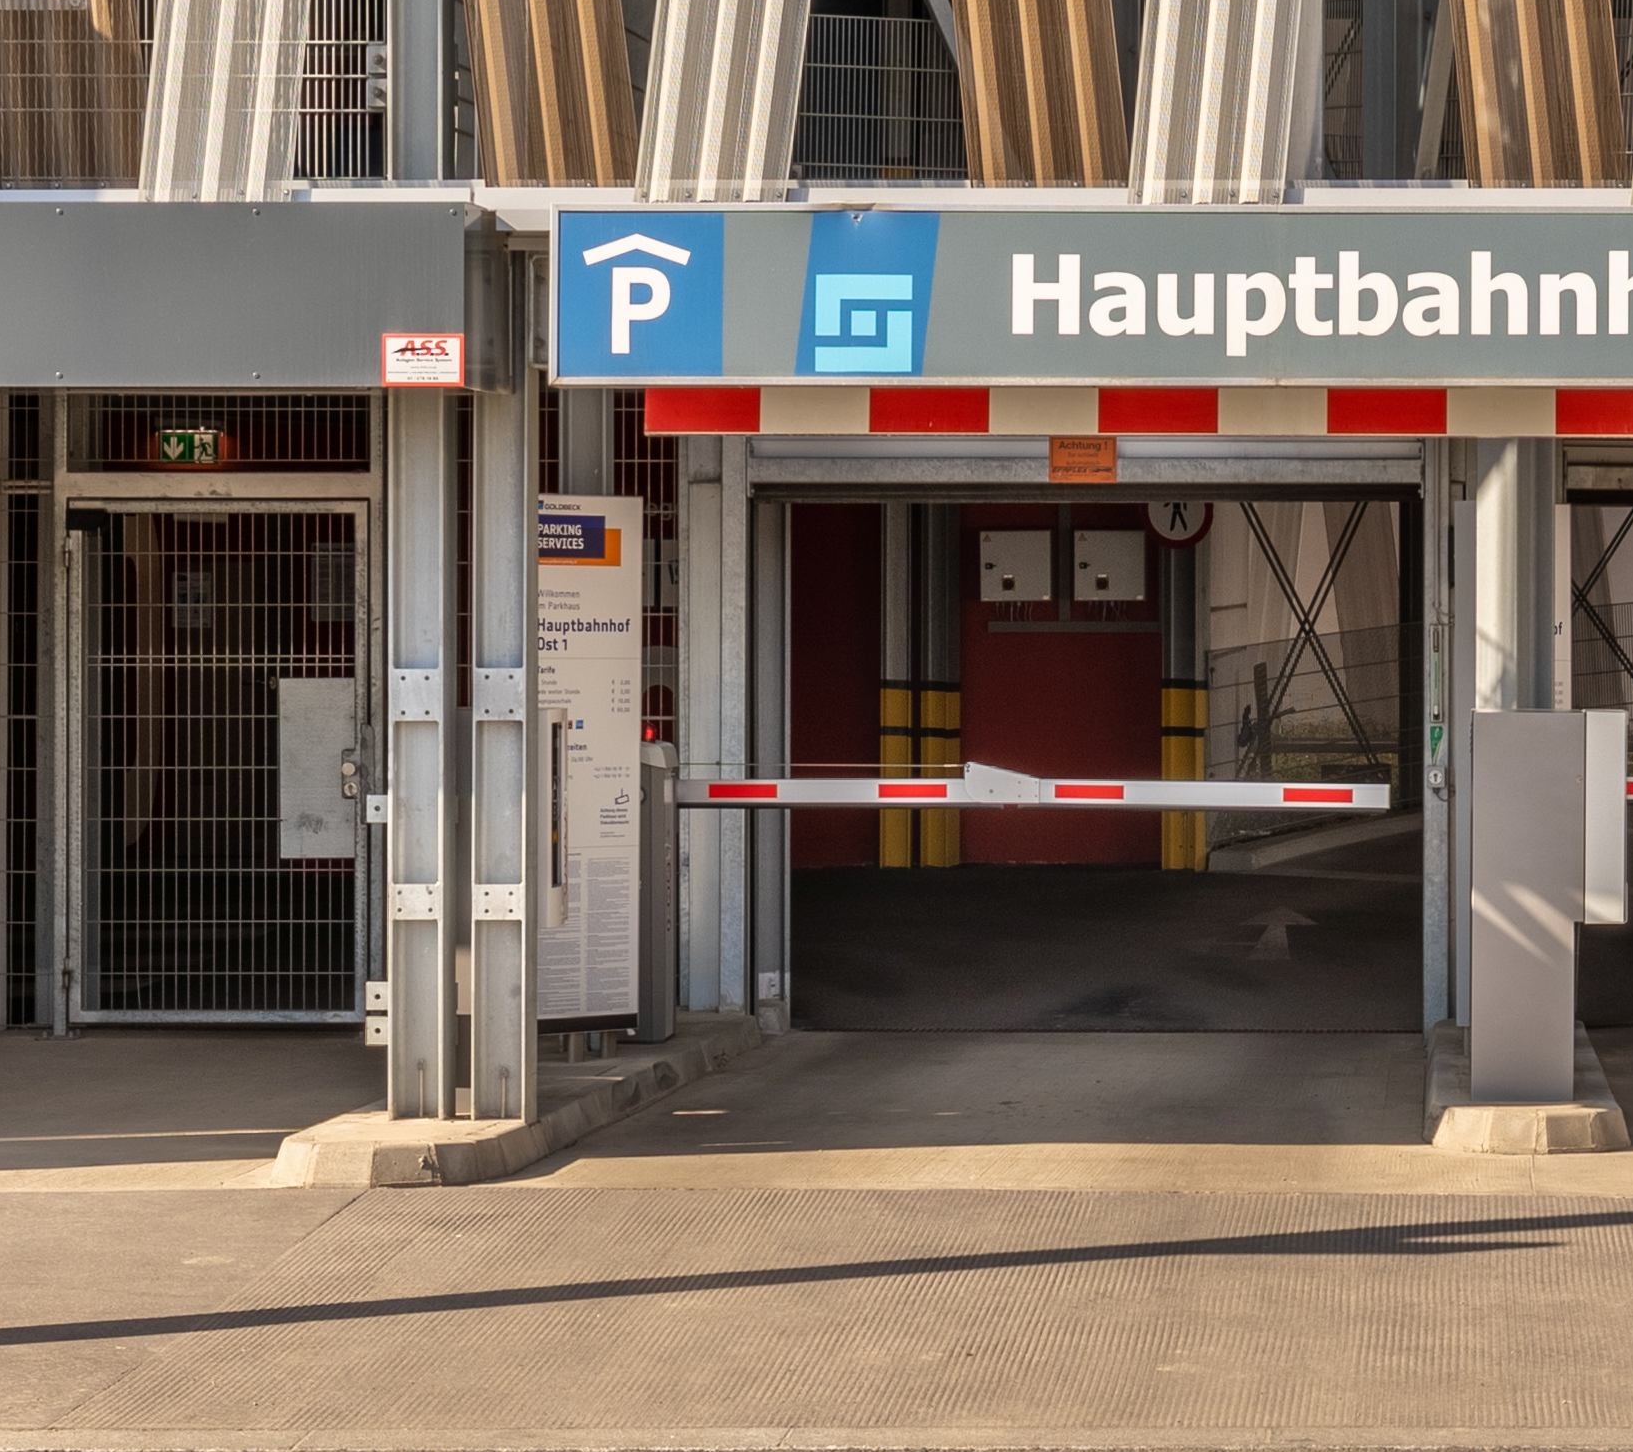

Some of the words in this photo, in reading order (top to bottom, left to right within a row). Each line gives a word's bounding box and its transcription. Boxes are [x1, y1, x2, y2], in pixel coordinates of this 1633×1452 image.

[610, 266, 671, 355] P
[1059, 440, 1101, 453] Achtung
[538, 524, 582, 536] PARKING
[538, 537, 584, 549] SERVICES
[538, 618, 630, 635] Hauptbahnhof
[538, 637, 558, 651] Ost
[562, 639, 567, 651] 1
